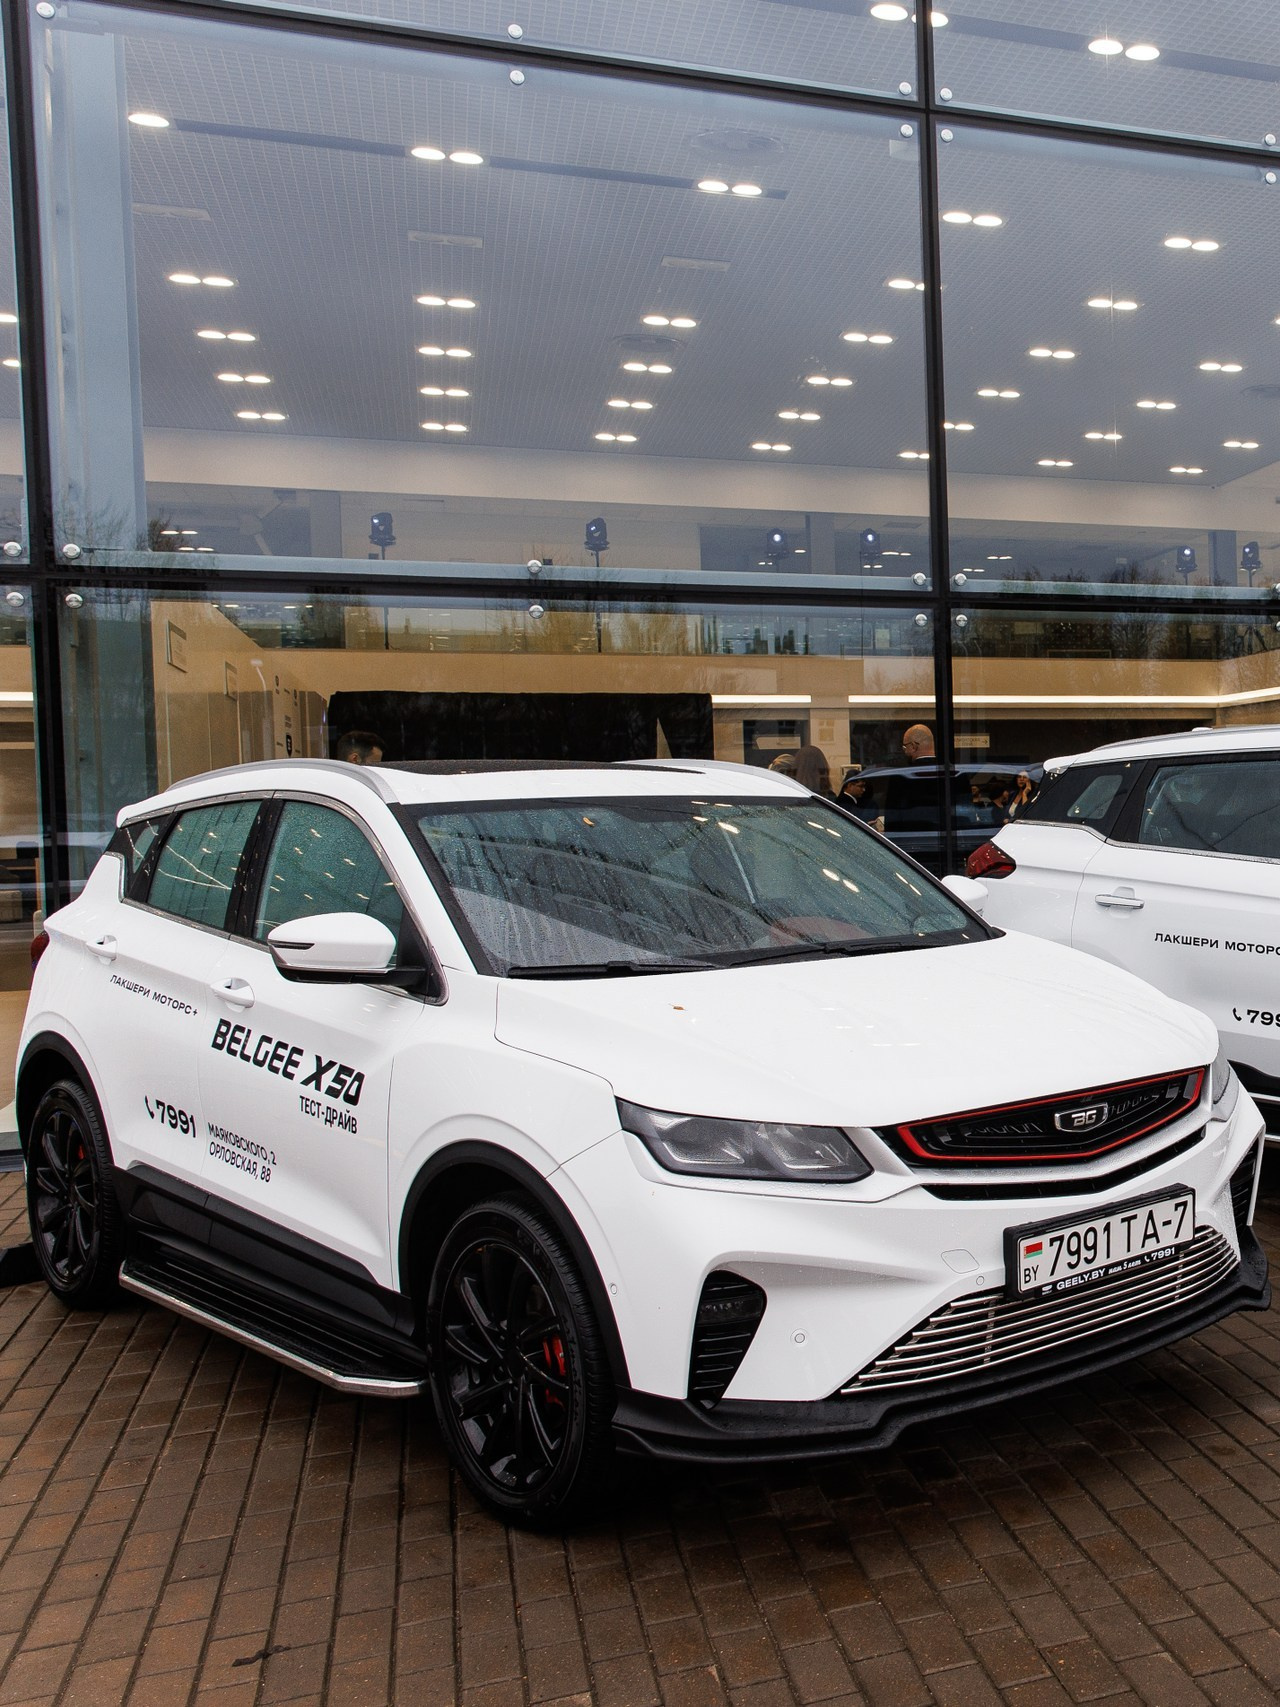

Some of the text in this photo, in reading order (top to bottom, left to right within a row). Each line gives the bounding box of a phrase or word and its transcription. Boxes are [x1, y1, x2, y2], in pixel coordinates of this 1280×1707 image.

[1154, 932, 1220, 950] ЛАКШЕРИ
[109, 974, 151, 998] ЛАКШЕРИ
[210, 1017, 366, 1106] BELGEE X50
[155, 1099, 197, 1138] 7991
[299, 1095, 358, 1134] ТЕСТ-ДРАЙВ
[207, 1122, 278, 1165] МАЯКОВСКОГО, 2
[208, 1141, 272, 1182] ОРЛОВСКАЯ, 88
[1049, 1200, 1189, 1277] 7991 TA-7
[1150, 1247, 1176, 1261] 7991
[1023, 1264, 1040, 1284] BY
[1056, 1268, 1106, 1291] GEELY.BY
